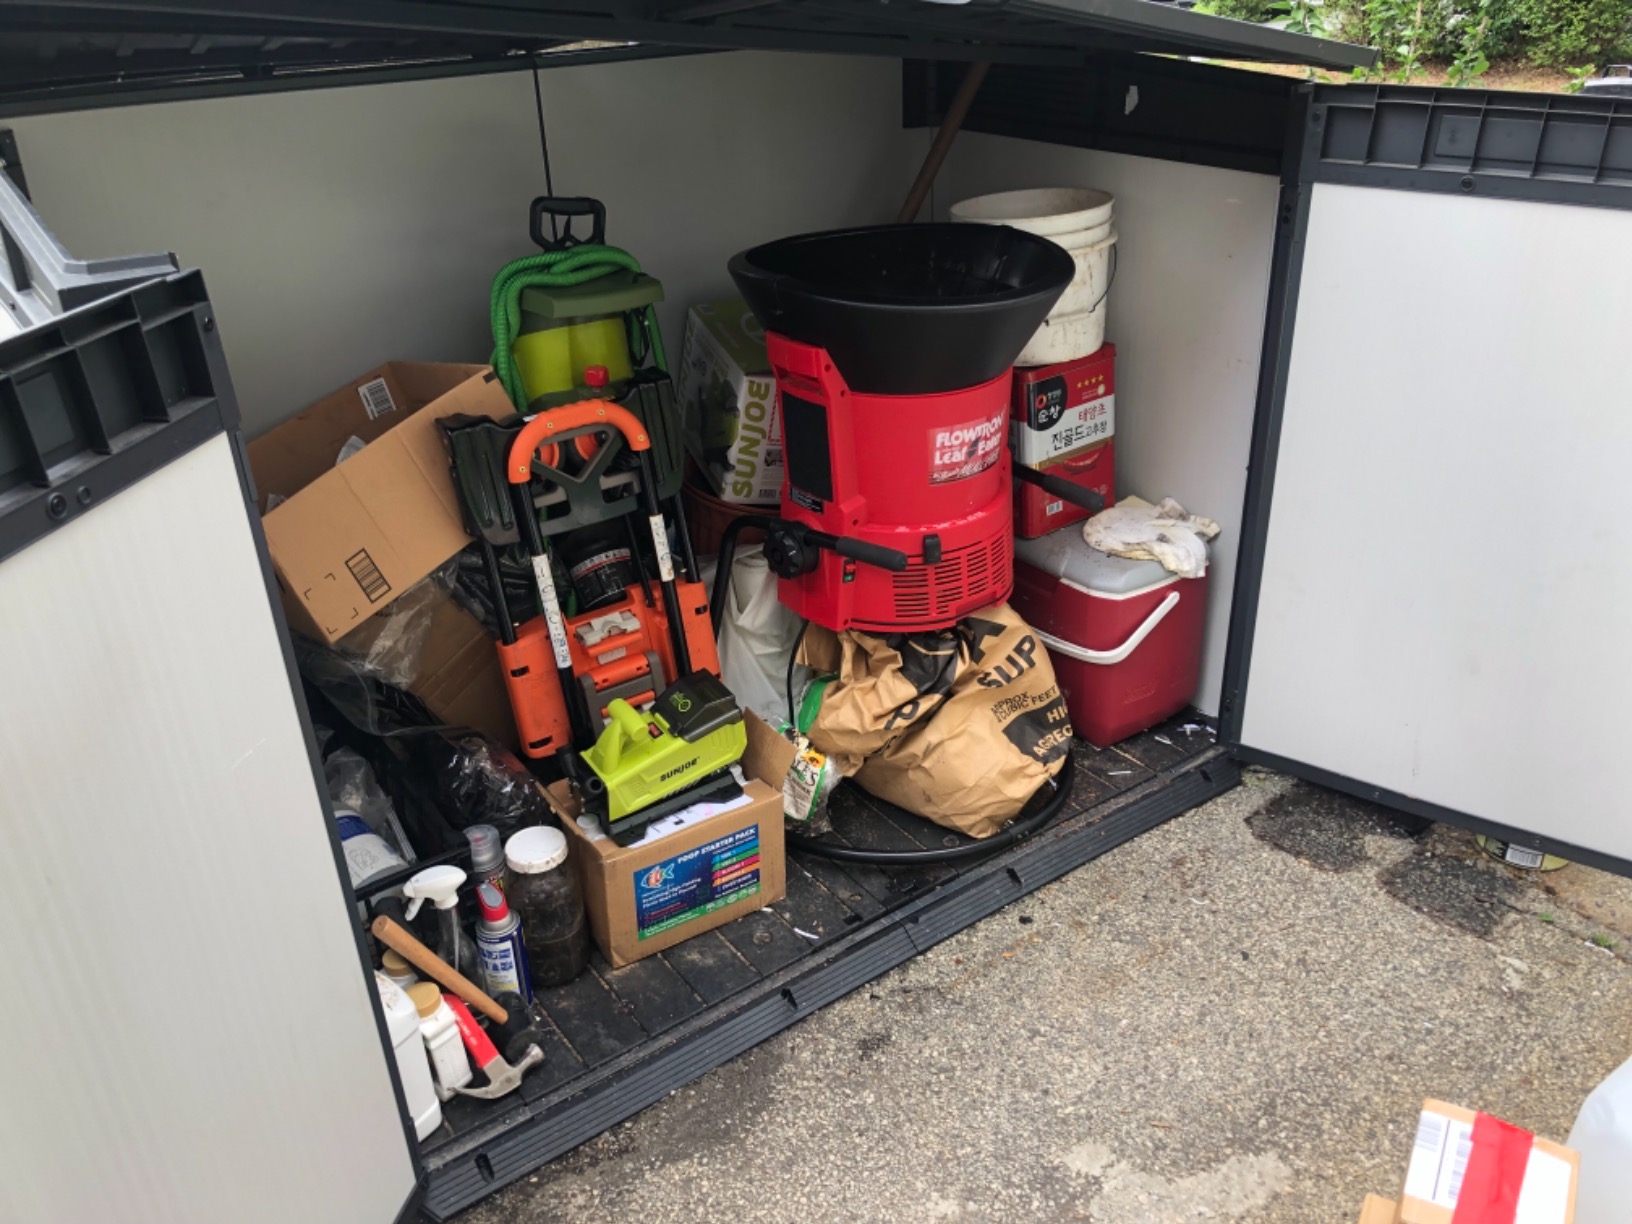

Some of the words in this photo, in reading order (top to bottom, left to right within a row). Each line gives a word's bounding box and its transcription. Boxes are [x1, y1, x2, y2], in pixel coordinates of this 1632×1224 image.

[1037, 404, 1062, 424] 순창
[1078, 402, 1107, 422] 태양초
[732, 380, 771, 498] SUNJOE
[935, 411, 1005, 449] FLOWTRON
[934, 445, 968, 466] Leaf
[1031, 685, 1057, 706] FEET
[660, 757, 698, 782] SUNJOE
[734, 826, 756, 841] PACK
